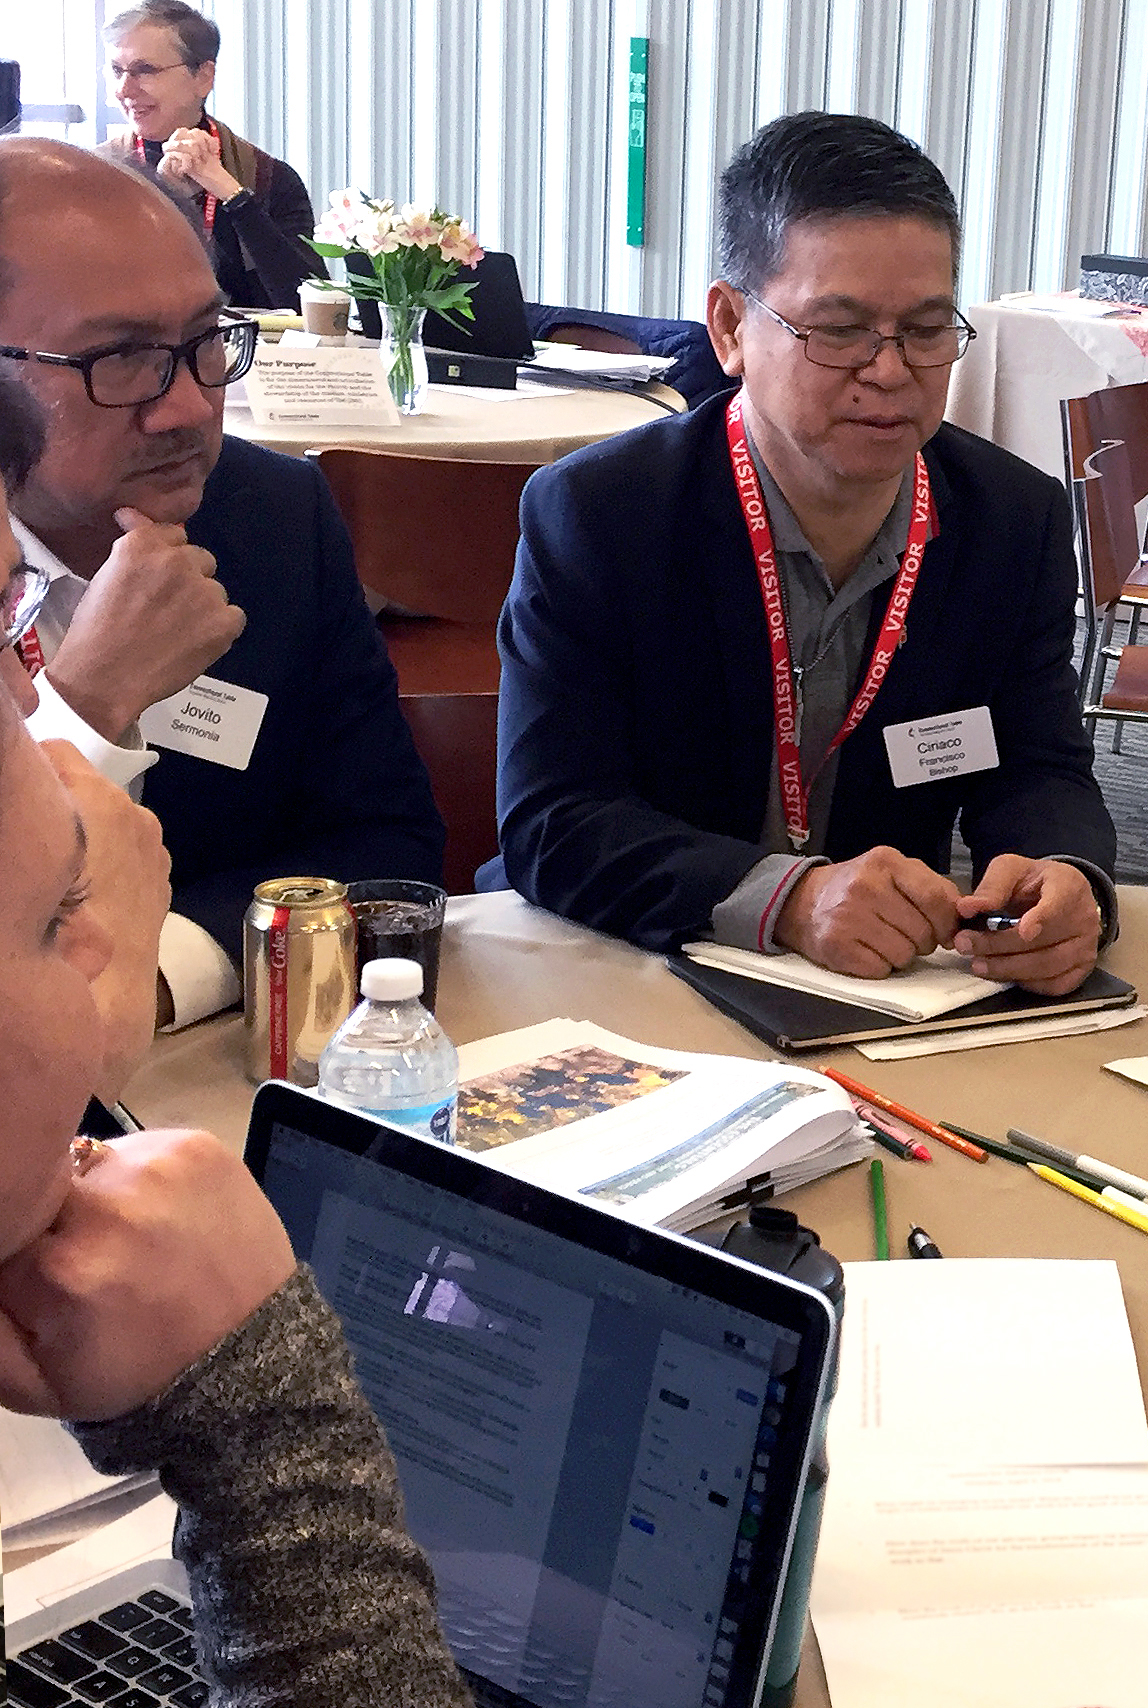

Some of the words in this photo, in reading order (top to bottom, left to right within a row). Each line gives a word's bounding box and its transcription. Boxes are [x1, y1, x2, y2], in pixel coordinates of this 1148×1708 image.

[276, 359, 316, 369] Purpose
[732, 438, 766, 533] VISITOR
[758, 549, 785, 643] VISITOR
[885, 542, 924, 632] VISITOR
[180, 702, 222, 725] Jovito
[775, 657, 796, 745] VISITOR
[844, 650, 893, 733] VISITOR
[171, 719, 220, 742] Sermonia
[919, 752, 966, 767] Francisco
[929, 765, 959, 777] Bishop
[782, 760, 803, 831] VISITO
[271, 930, 286, 970] Coke
